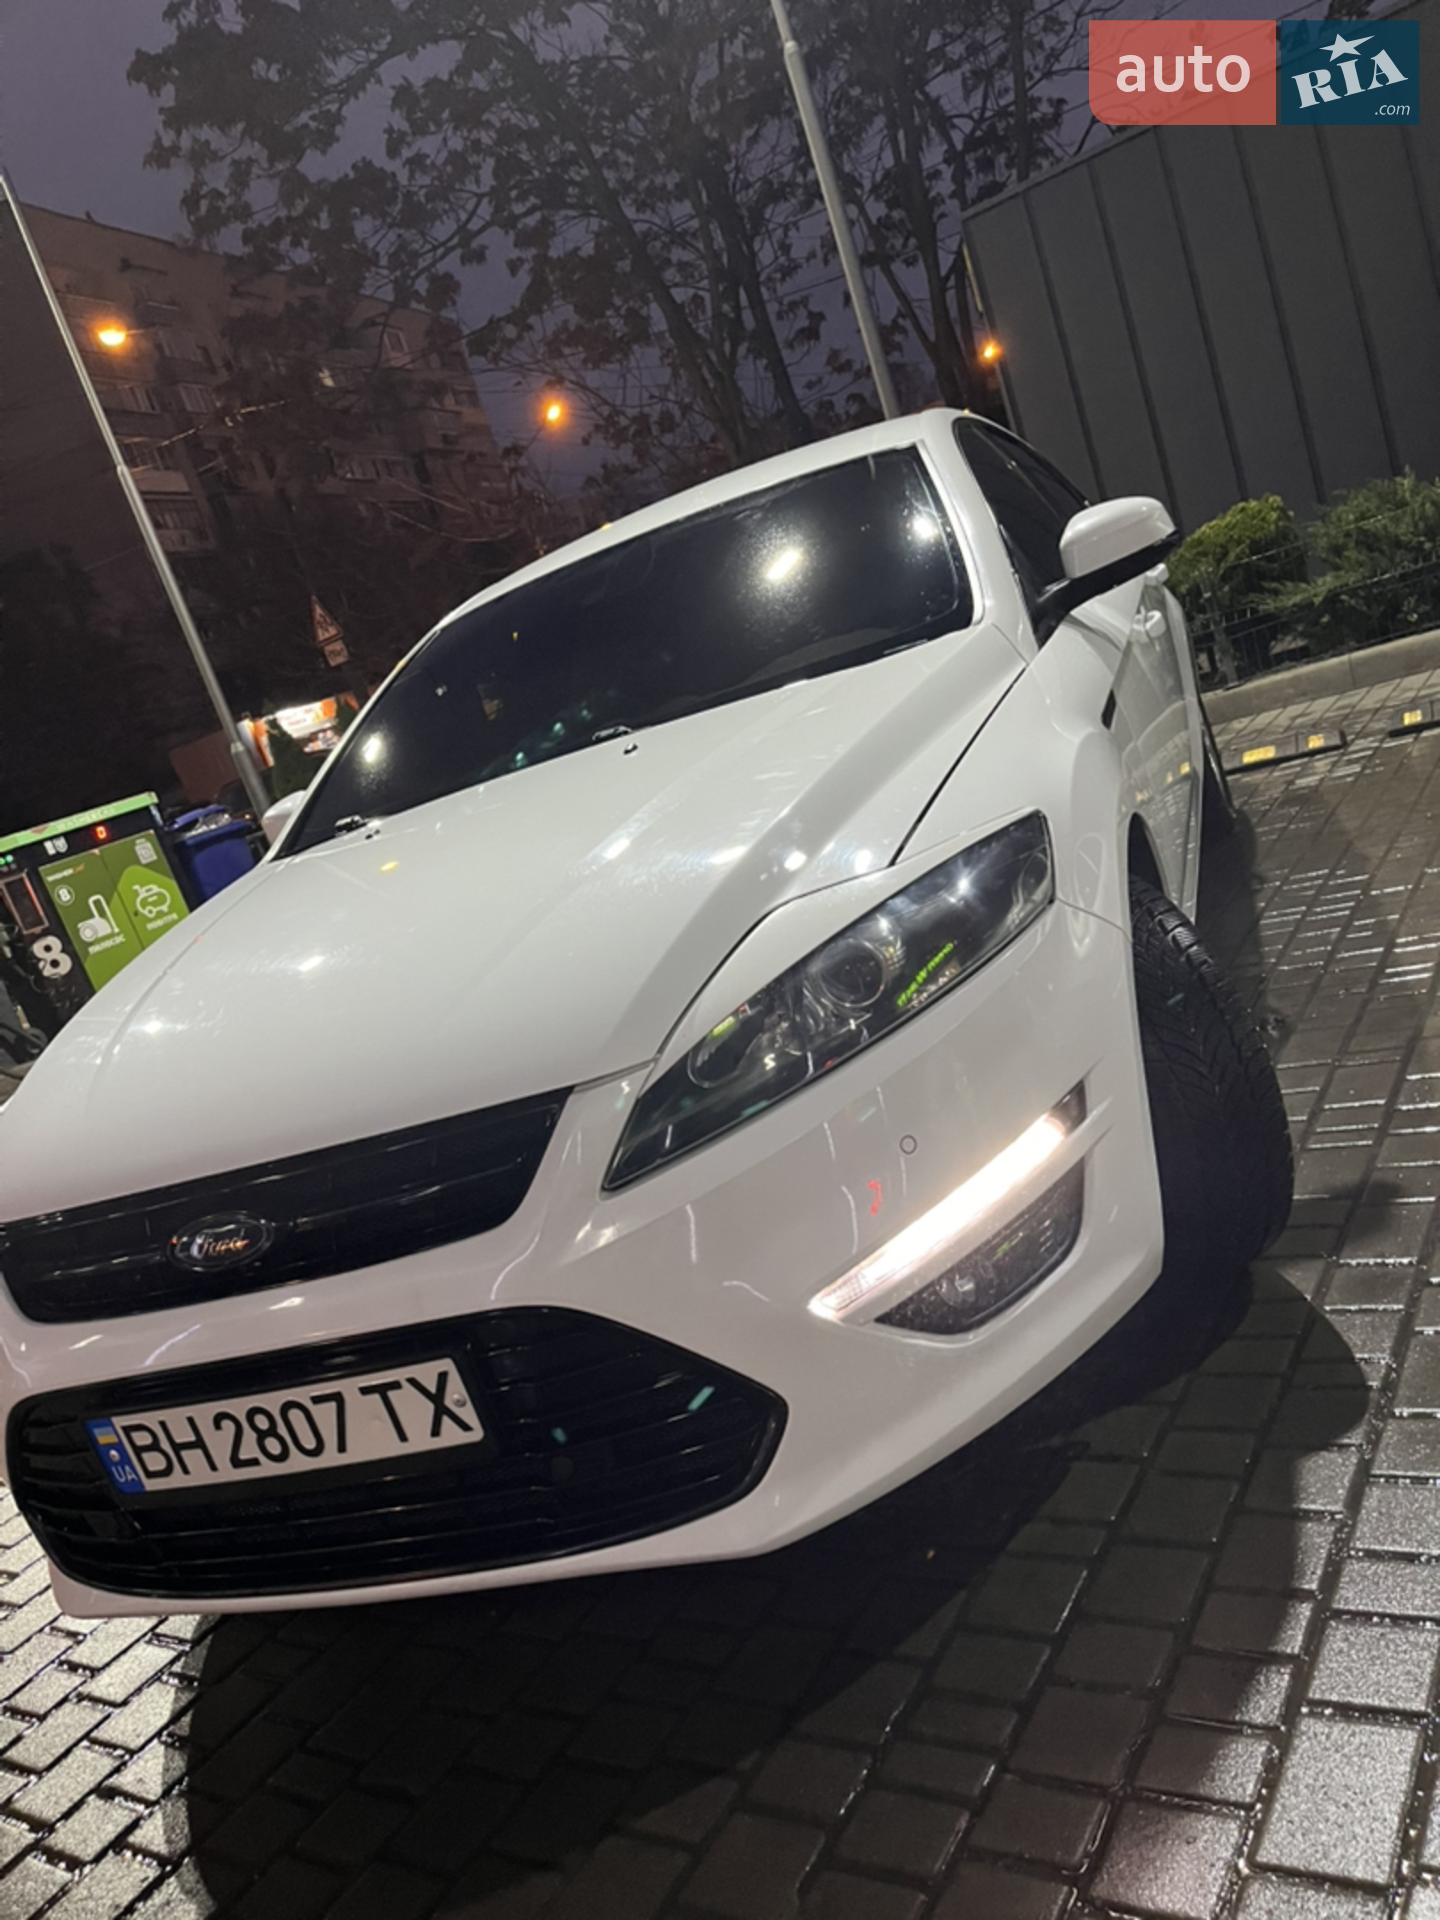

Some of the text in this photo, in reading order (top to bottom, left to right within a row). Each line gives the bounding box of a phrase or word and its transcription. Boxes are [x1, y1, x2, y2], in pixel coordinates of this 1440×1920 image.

[32, 935, 72, 979] 8
[120, 1370, 474, 1479] BH 2807 TX
[110, 1464, 138, 1483] UA
